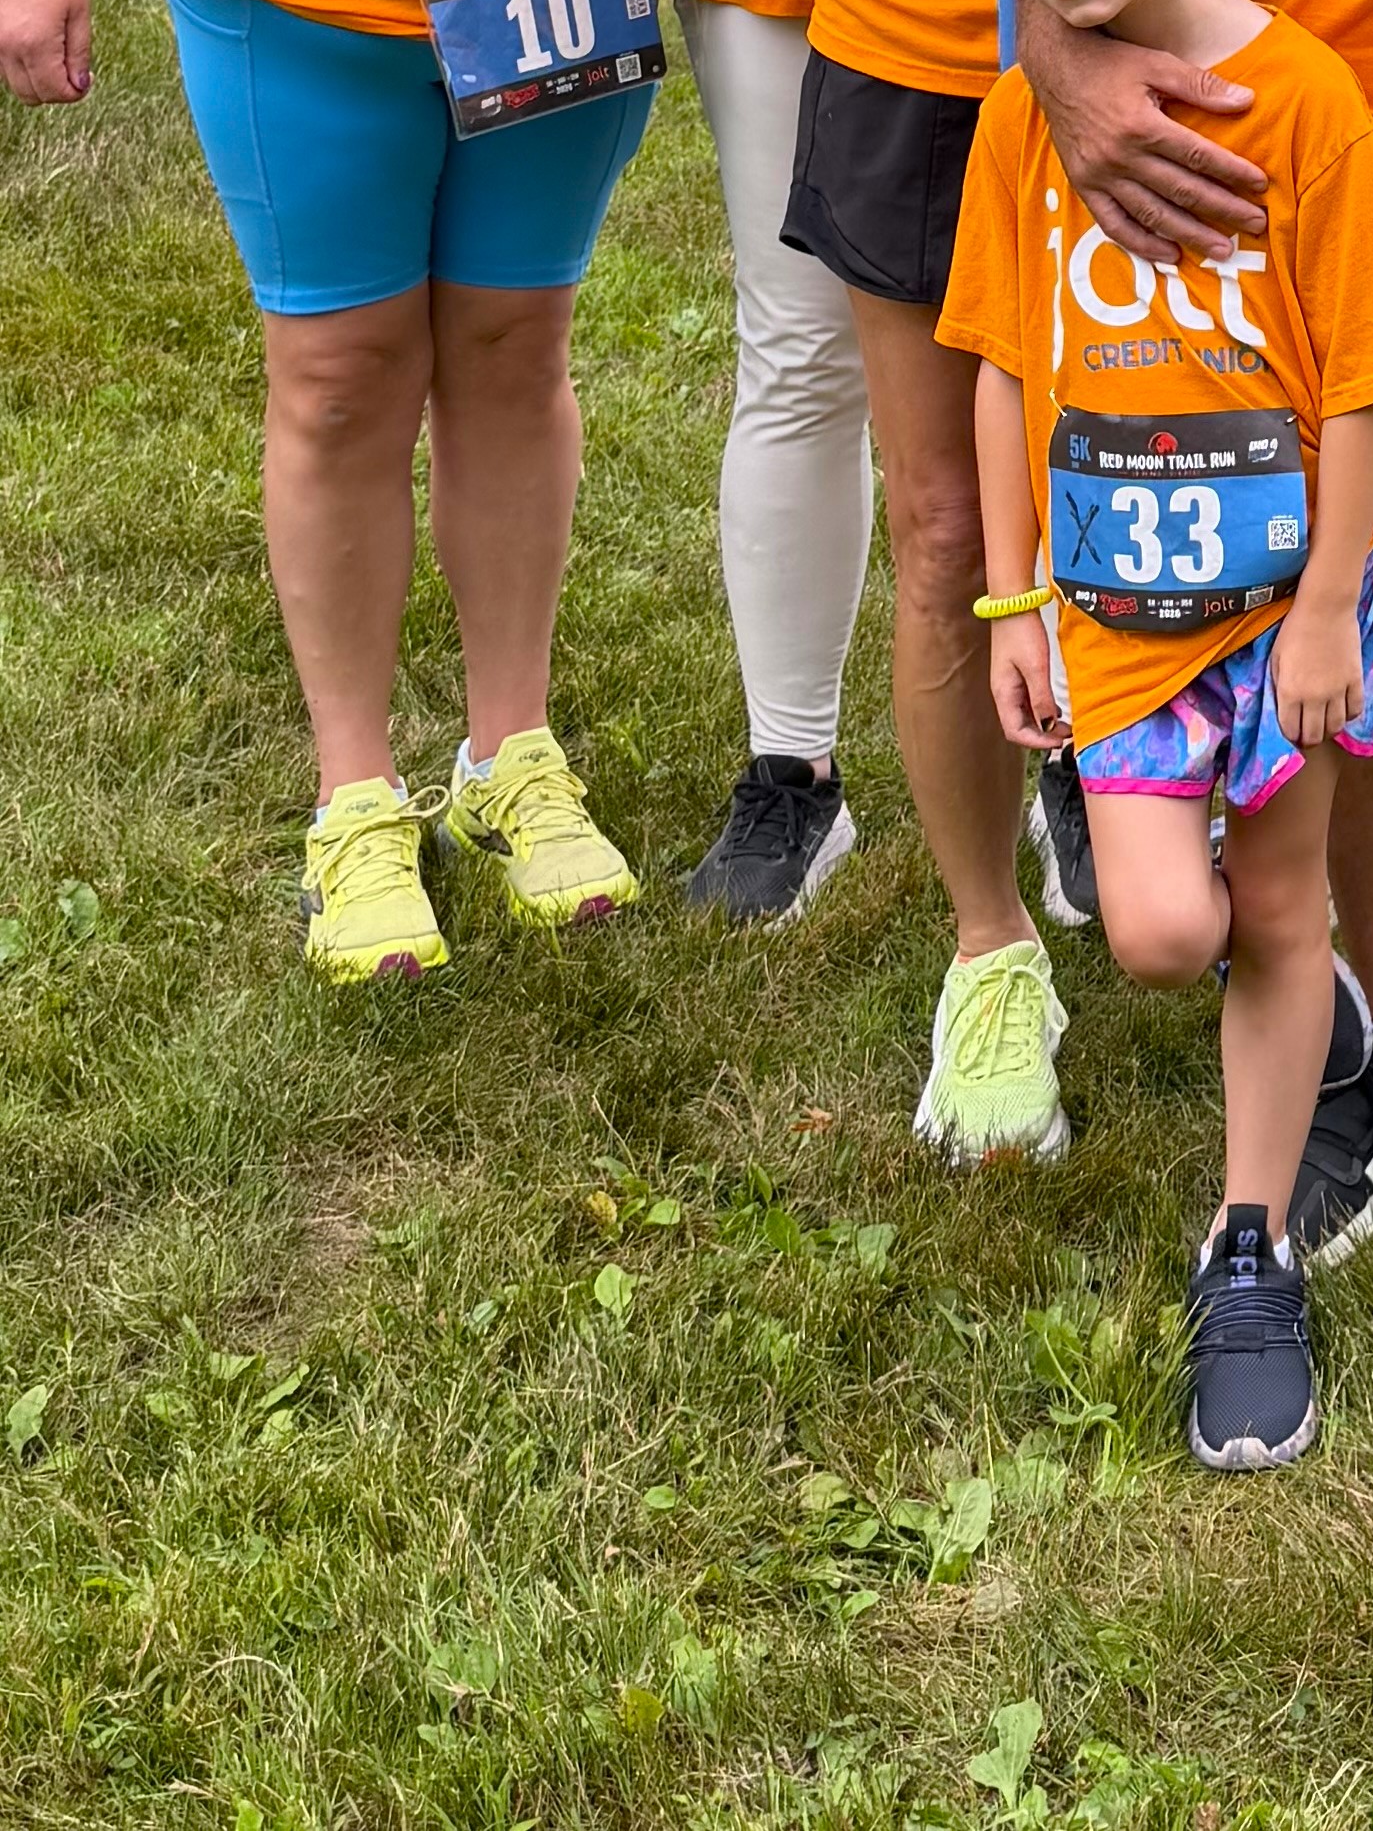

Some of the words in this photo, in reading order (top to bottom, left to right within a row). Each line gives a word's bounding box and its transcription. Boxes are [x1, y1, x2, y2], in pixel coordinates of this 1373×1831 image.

[1083, 337, 1184, 372] CREDIT
[1195, 344, 1273, 375] NIO
[1069, 434, 1091, 461] 5K
[1099, 451, 1123, 469] RED
[1126, 454, 1164, 470] MOON
[1166, 453, 1206, 469] TRAIL
[1209, 450, 1236, 467] RUN
[1111, 486, 1225, 584] 33
[1204, 598, 1234, 617] jolt
